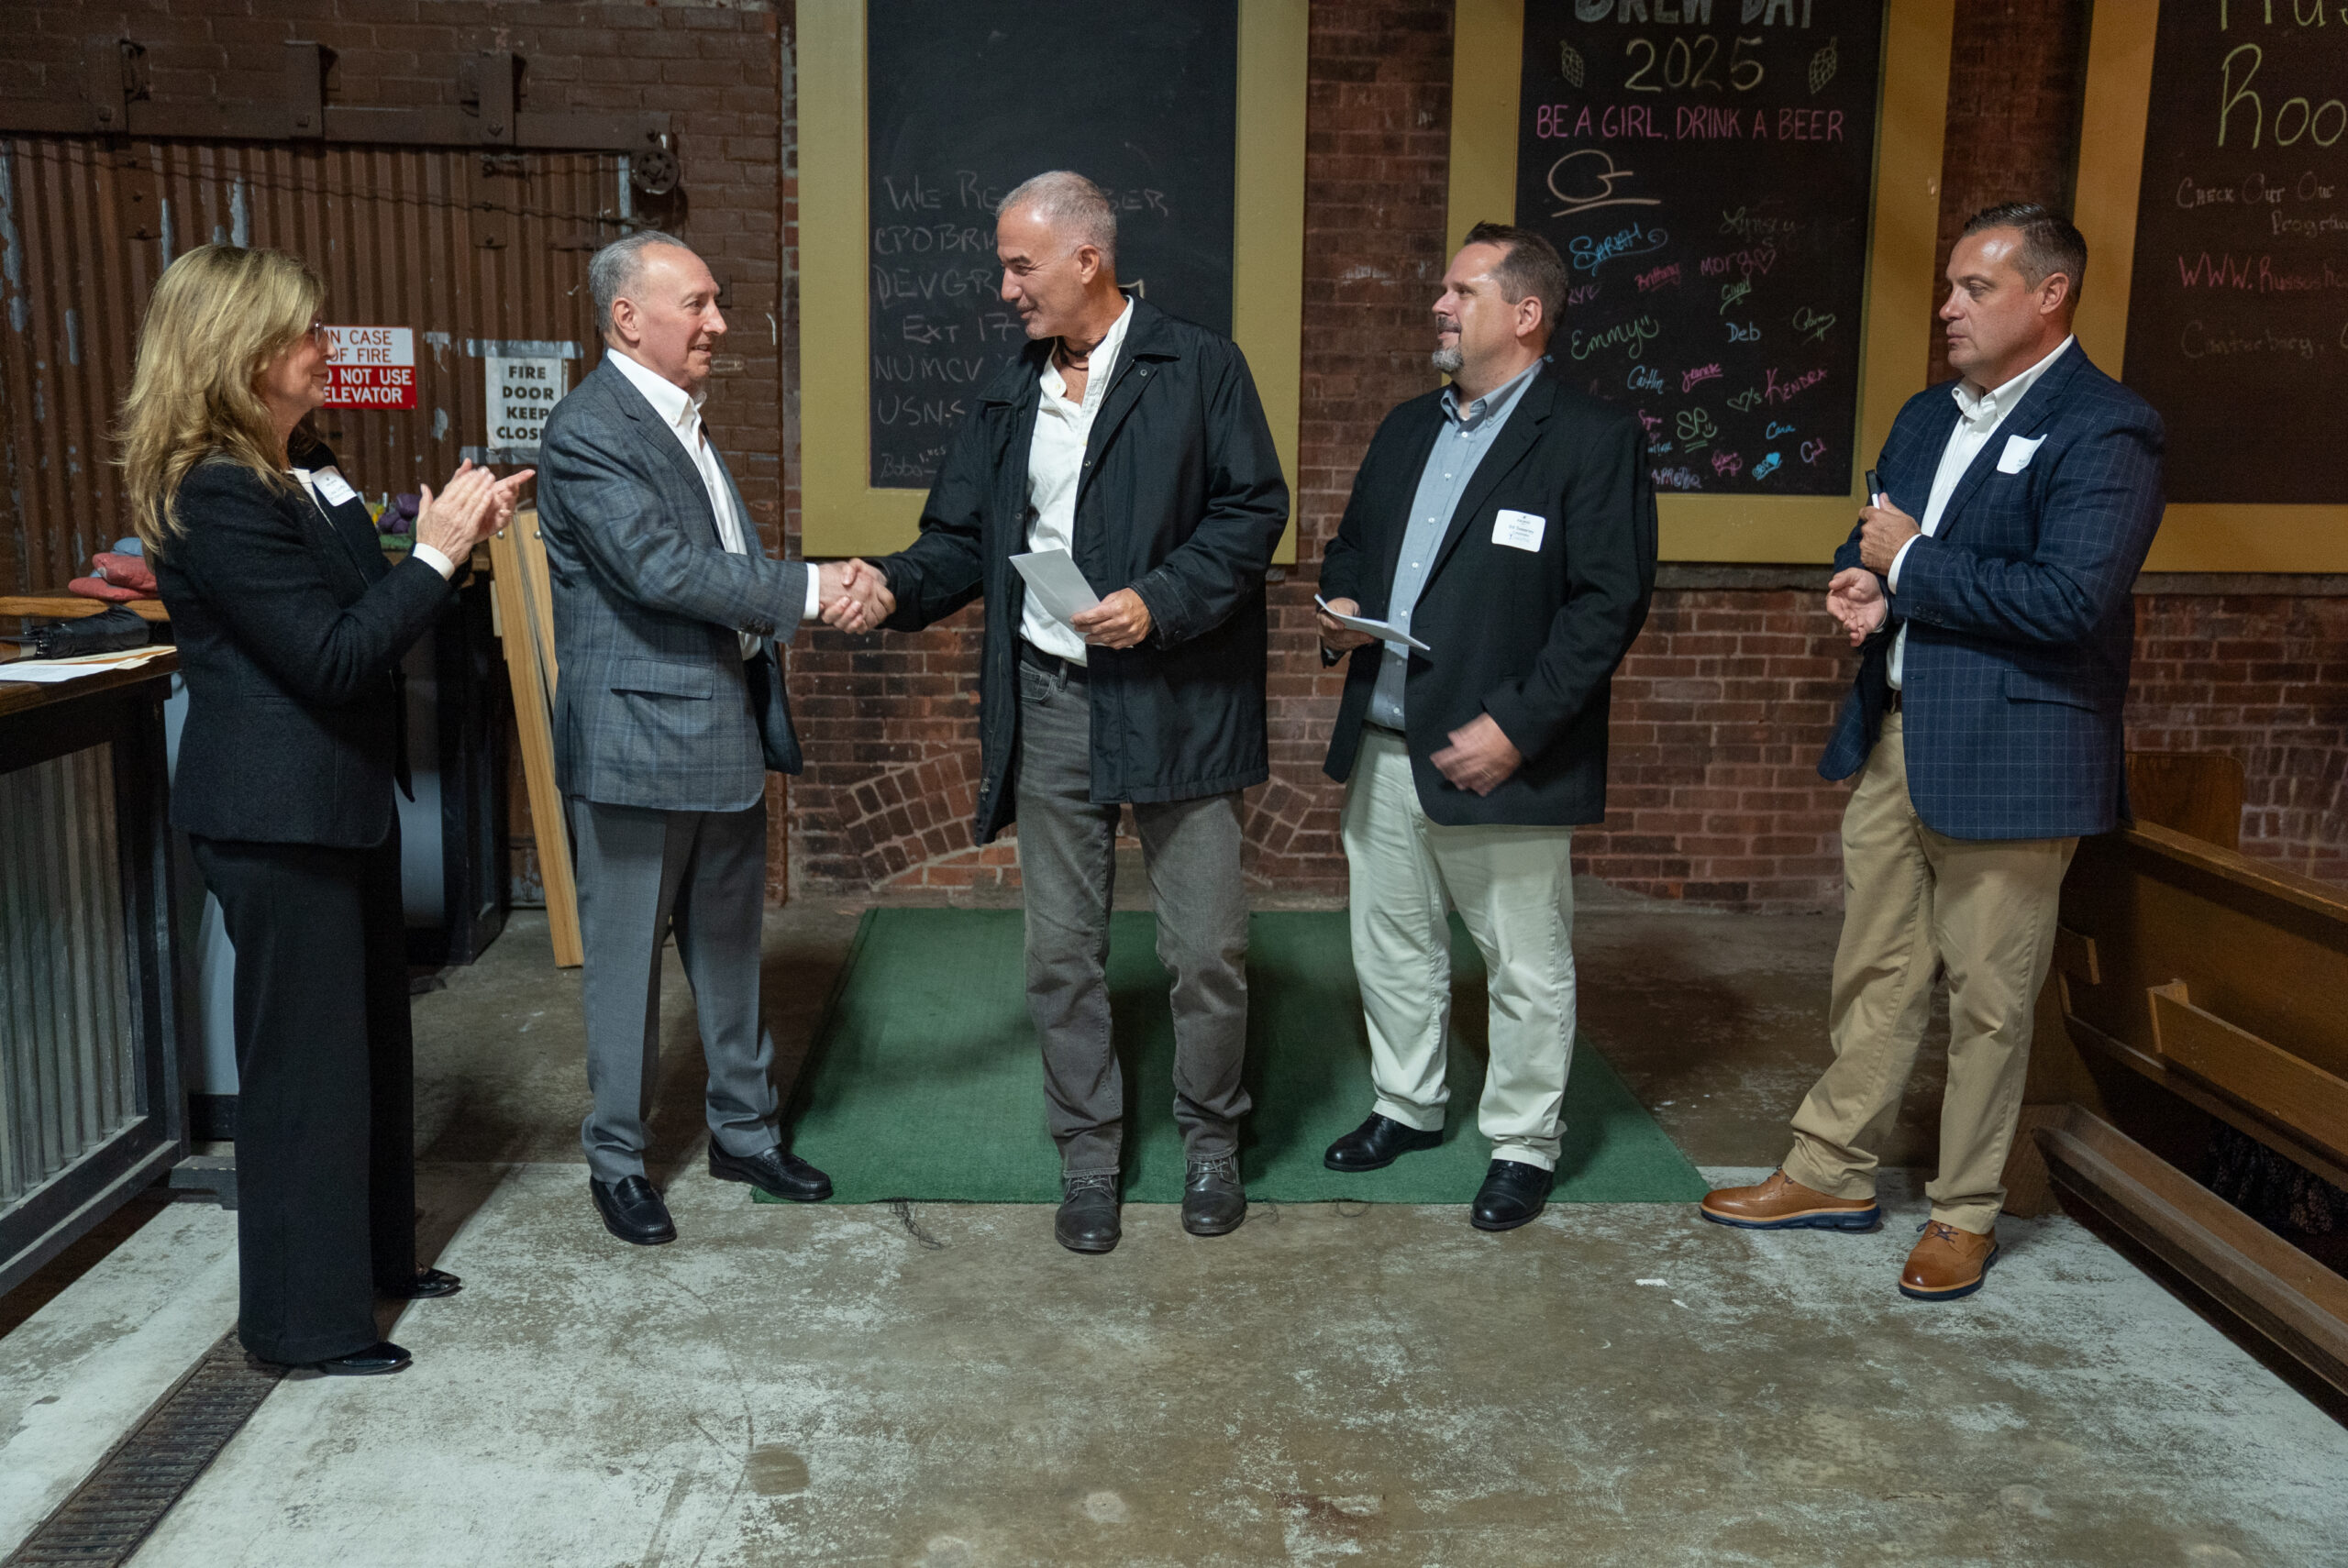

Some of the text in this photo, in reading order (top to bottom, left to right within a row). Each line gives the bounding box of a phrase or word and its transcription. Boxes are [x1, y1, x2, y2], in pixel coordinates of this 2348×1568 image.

[1624, 34, 1765, 92] 2025
[1536, 105, 1569, 139] BE
[1574, 107, 1593, 137] A
[1677, 105, 1743, 140] DRINK
[1752, 109, 1768, 140] A
[1778, 108, 1844, 142] BEER
[349, 330, 393, 346] CASE
[1725, 321, 1761, 343] Deb
[357, 348, 392, 363] FIRE
[340, 368, 371, 385] NOT
[380, 369, 412, 386] USE
[508, 365, 546, 380] FIRE
[323, 386, 403, 403] ELEVATOR
[502, 386, 554, 401] DOOR
[506, 406, 549, 420] KEEP
